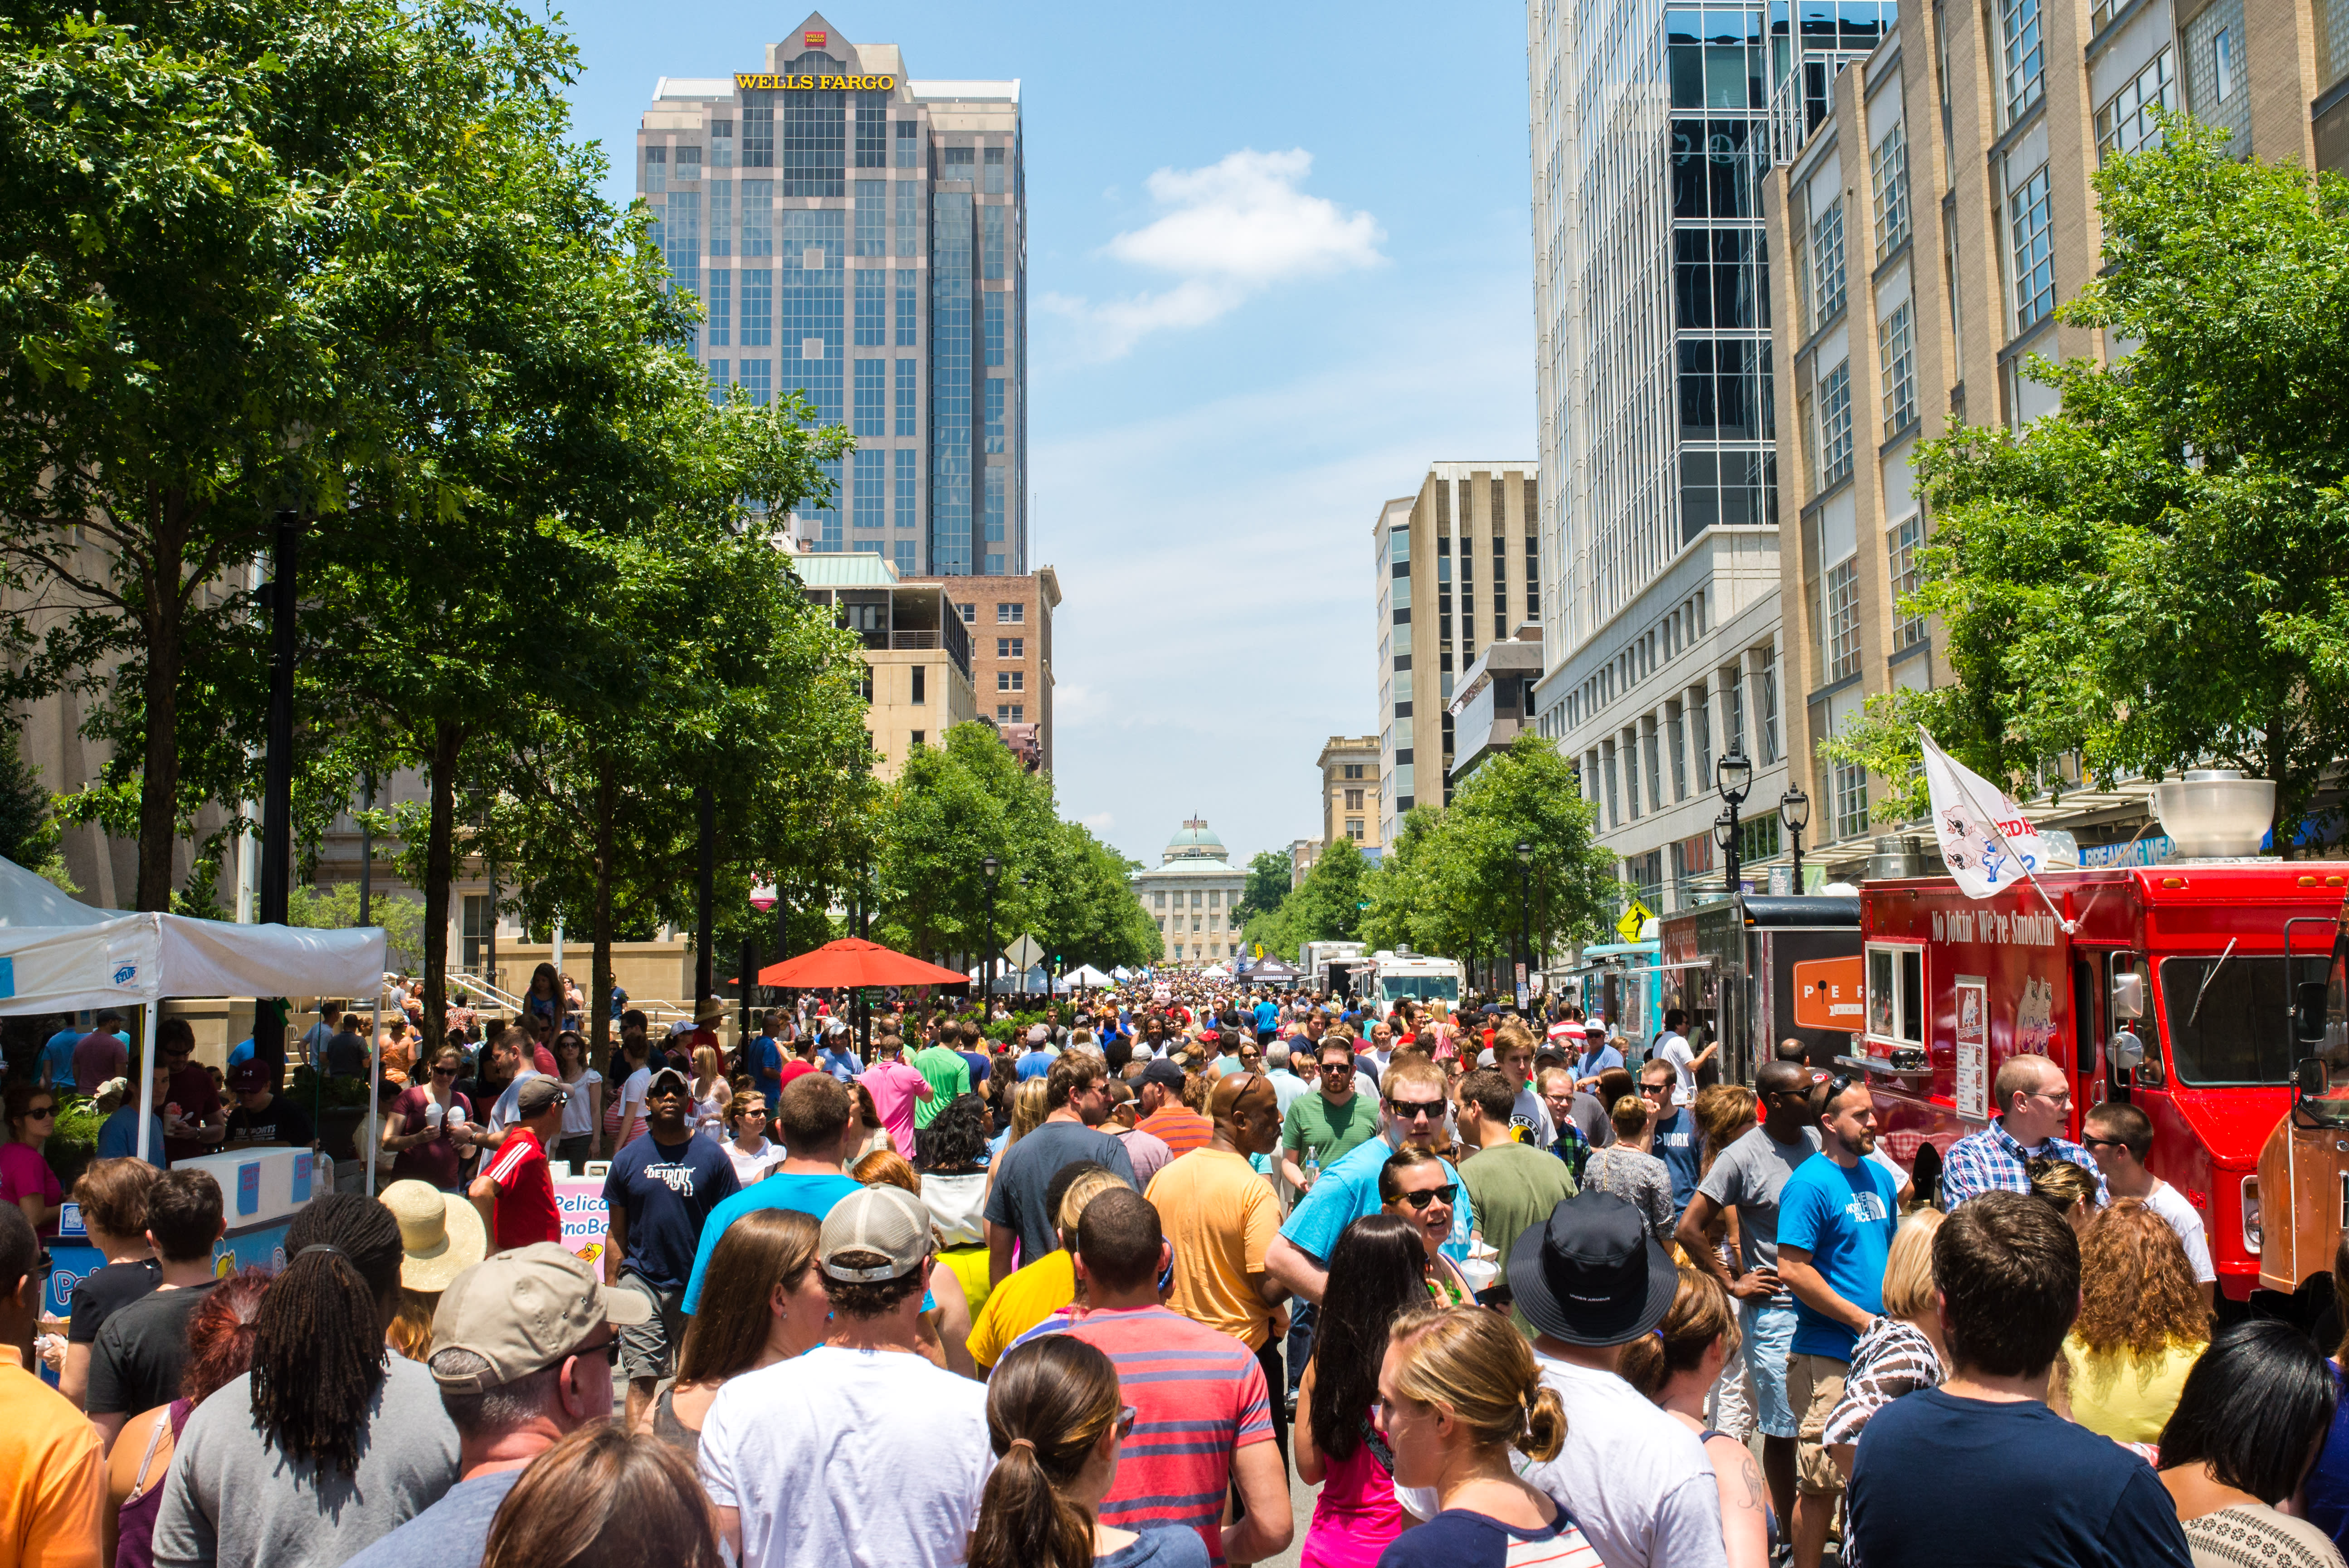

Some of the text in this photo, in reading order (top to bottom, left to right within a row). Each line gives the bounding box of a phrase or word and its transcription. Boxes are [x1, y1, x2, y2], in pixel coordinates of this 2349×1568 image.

[735, 74, 894, 90] WELLS FARGO
[2085, 841, 2144, 867] BREAKING
[1932, 911, 1944, 942] No
[1946, 910, 1975, 946] Jokin'
[1978, 910, 2008, 944] We're
[644, 1166, 696, 1196] DETROIT
[1851, 1192, 1867, 1203] THE
[1845, 1201, 1869, 1215] NORTH
[1855, 1211, 1871, 1222] FACE
